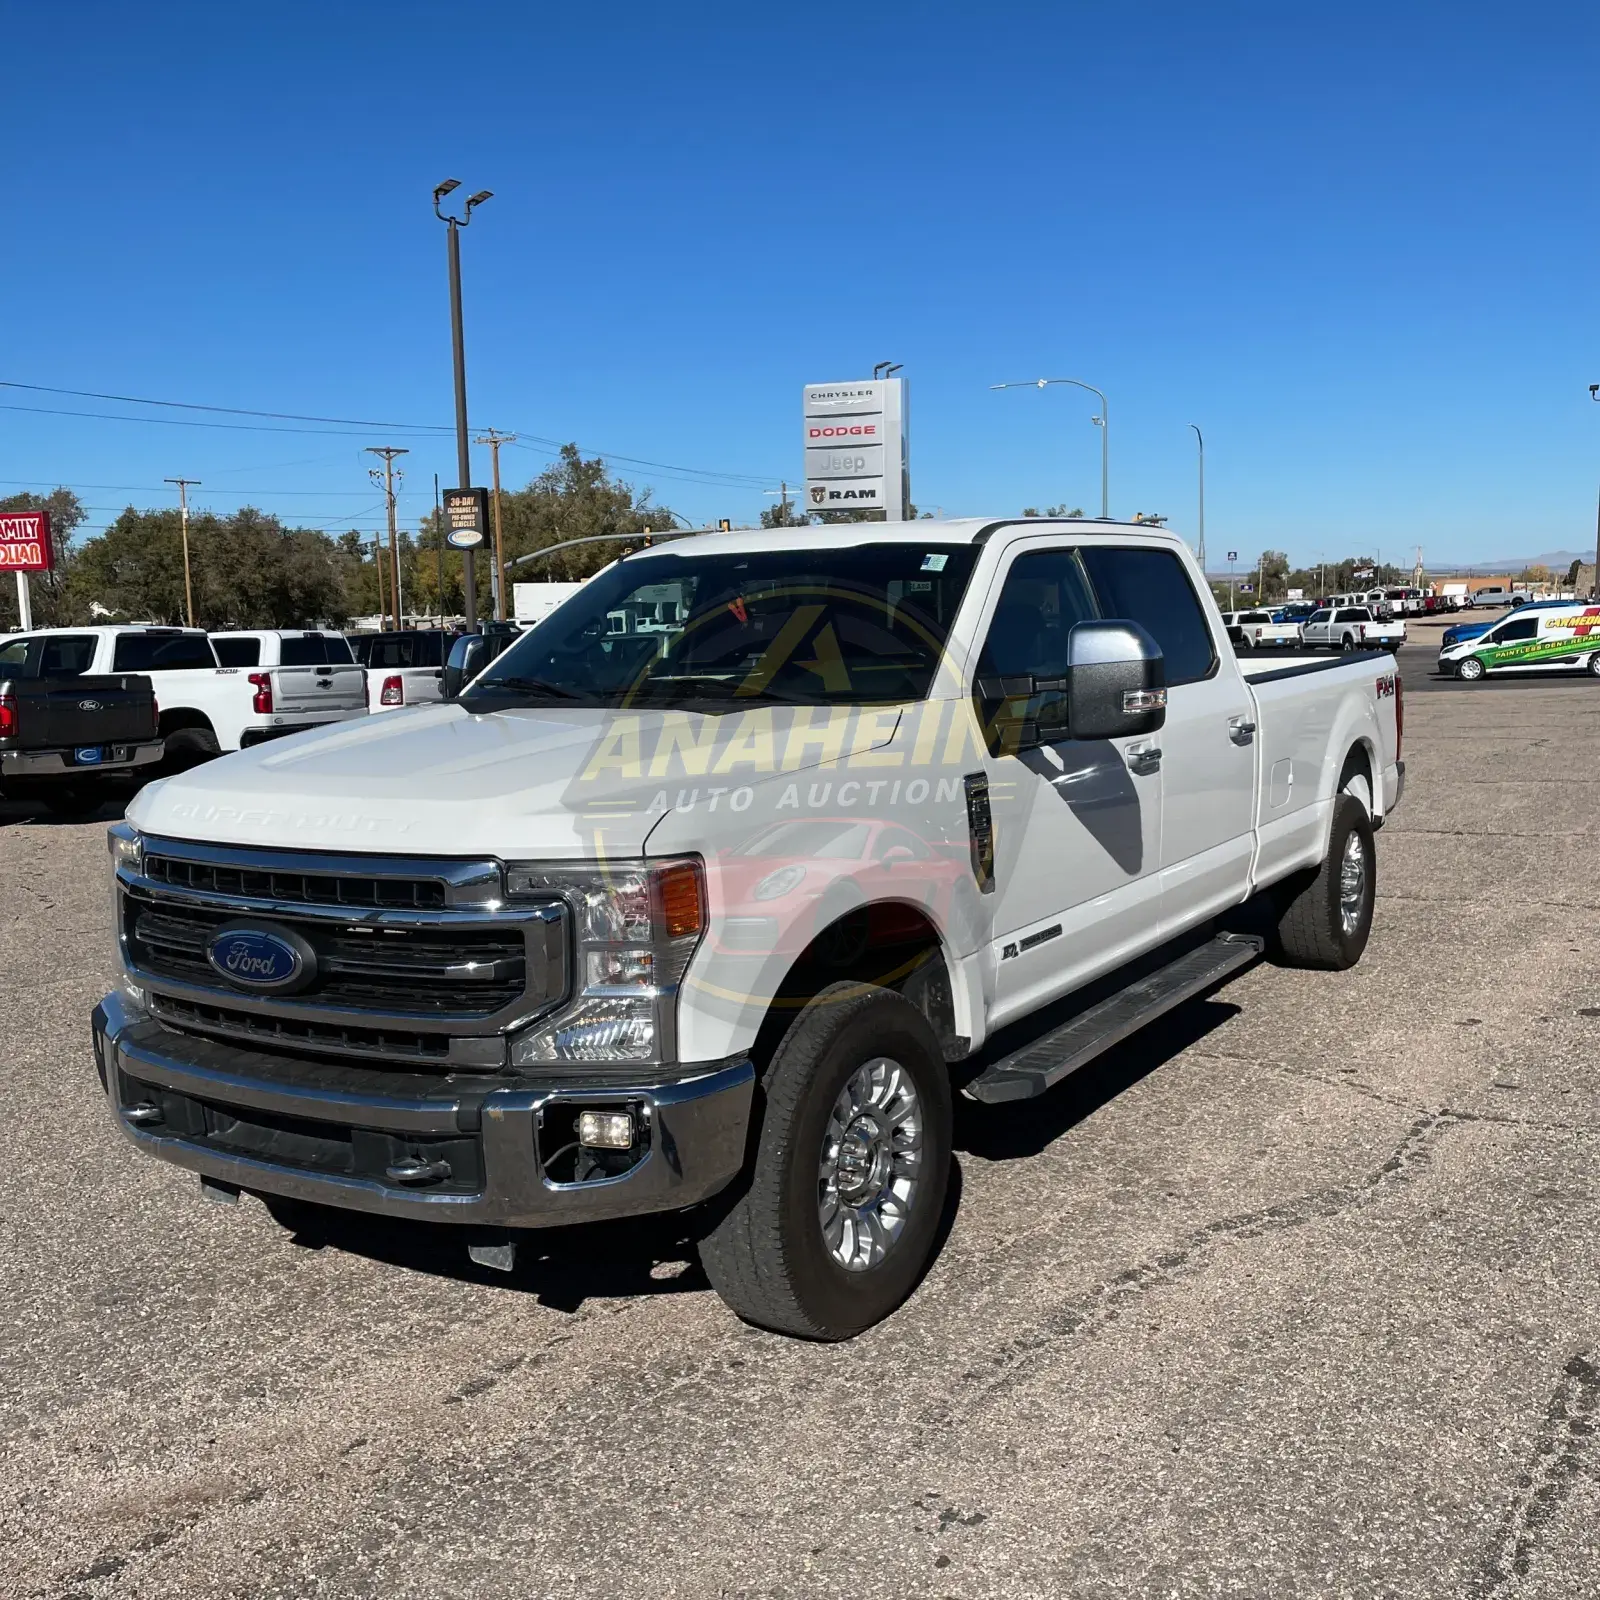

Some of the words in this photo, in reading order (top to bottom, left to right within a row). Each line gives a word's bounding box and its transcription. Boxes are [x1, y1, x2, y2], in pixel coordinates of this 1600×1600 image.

[811, 390, 873, 399] CHRYSLER
[809, 425, 876, 438] DODGE
[820, 455, 866, 473] Jeep
[829, 489, 876, 500] RAM
[451, 497, 475, 506] 30-DAY
[1495, 644, 1542, 658] PAINTLESS
[1544, 640, 1567, 649] DENT
[226, 941, 276, 975] Ford
